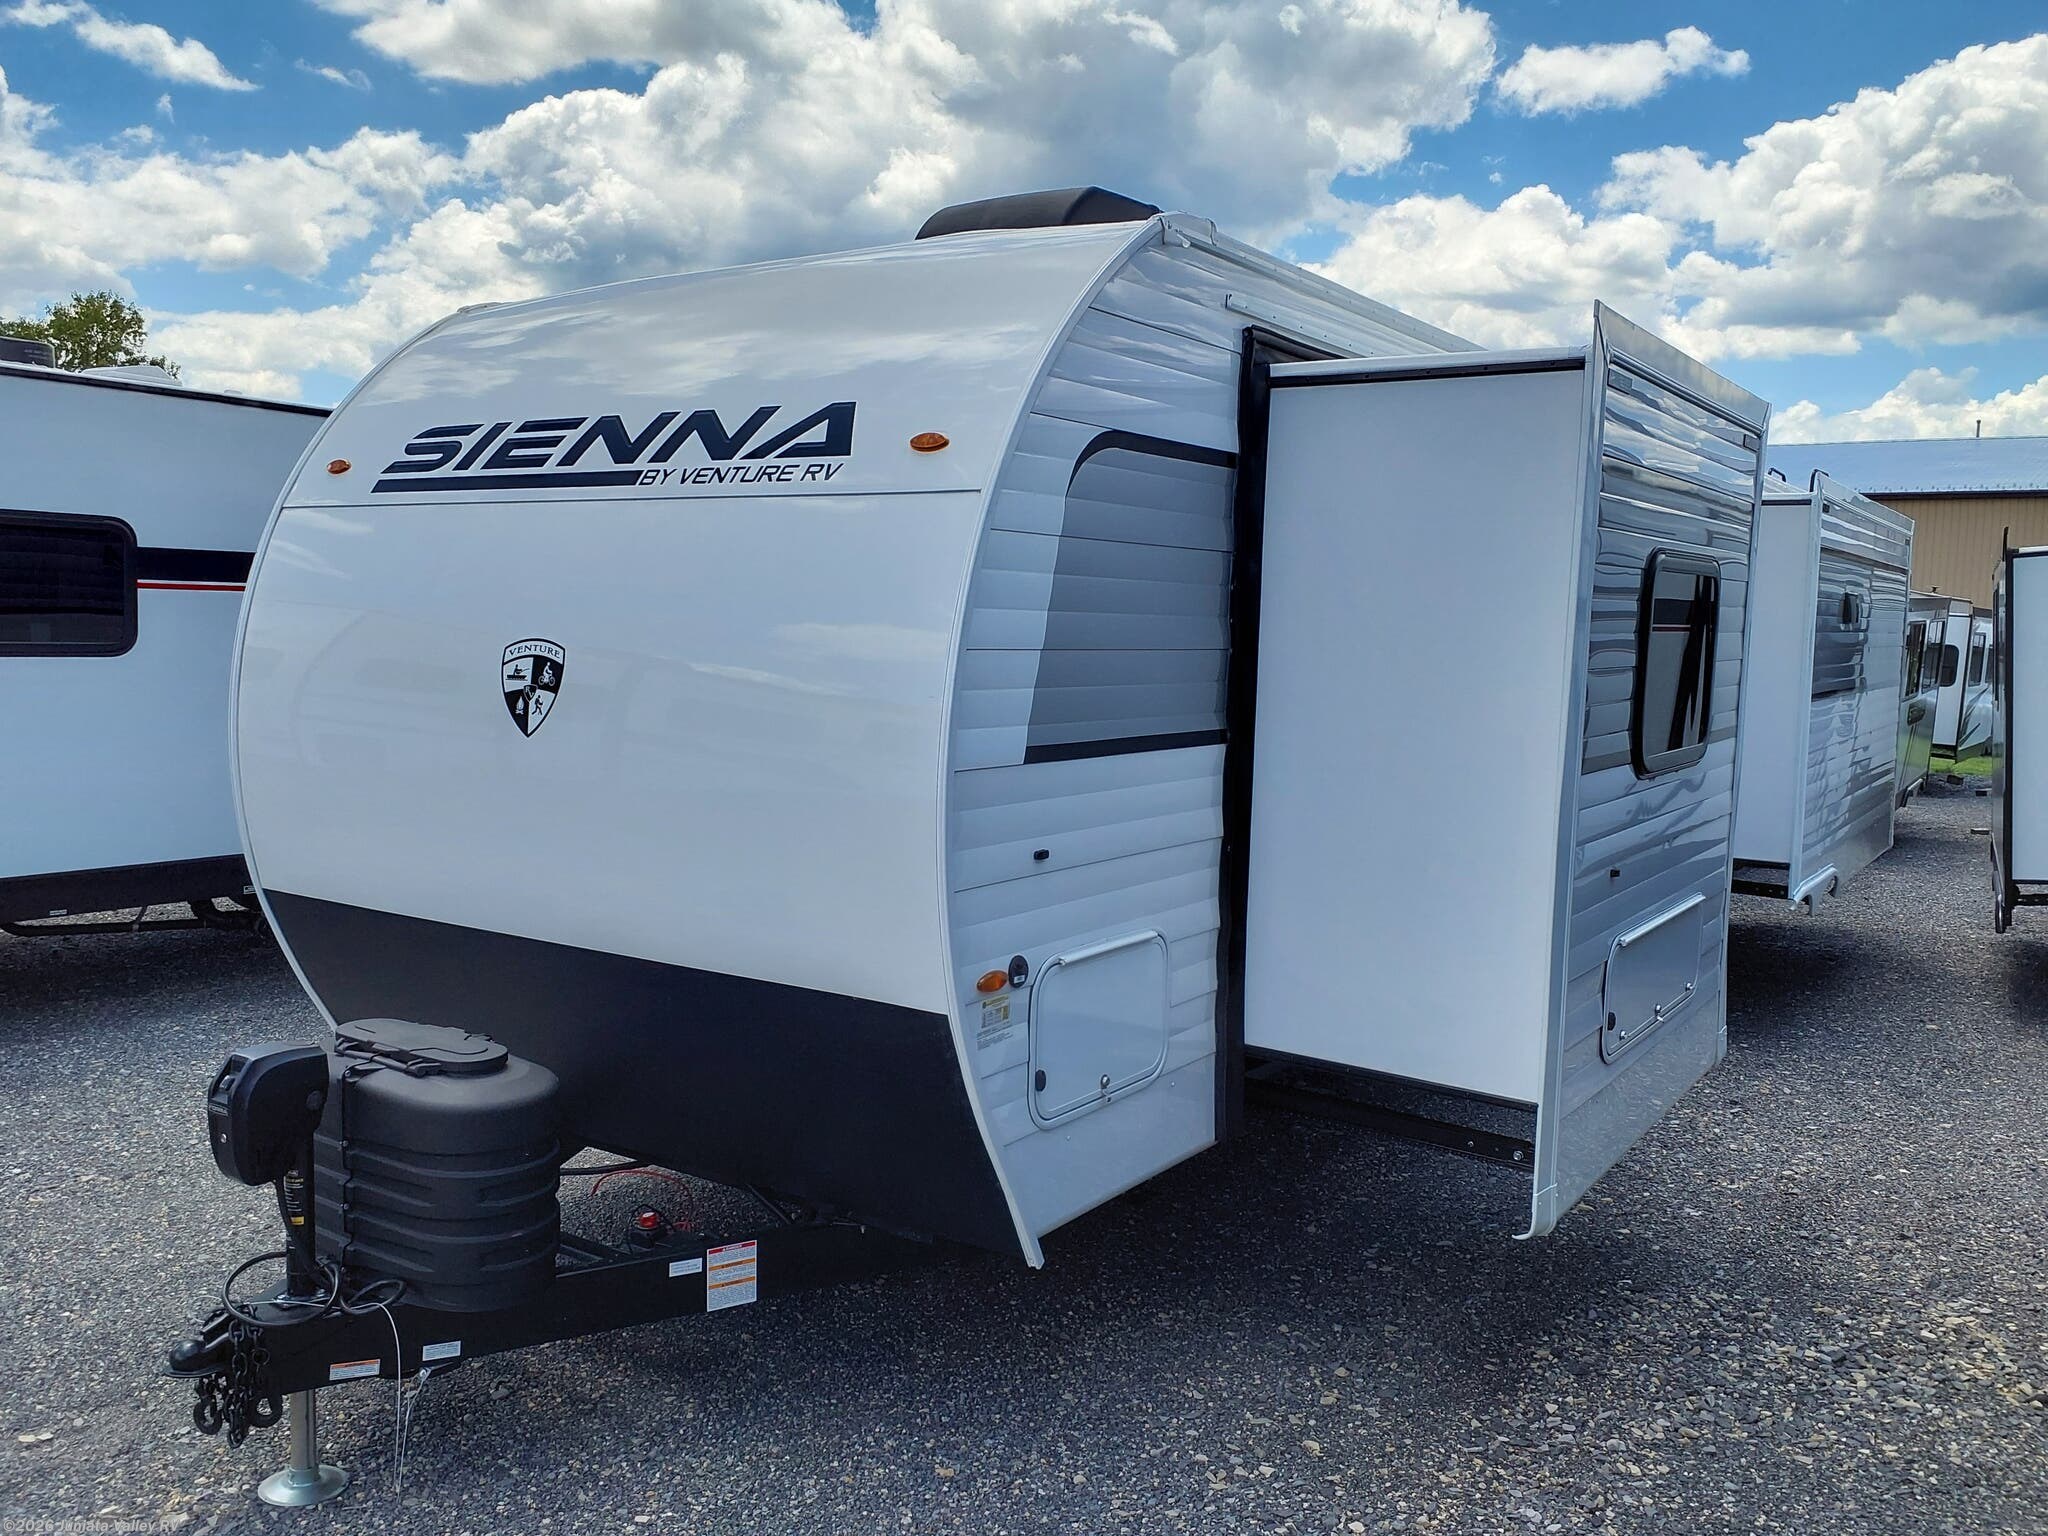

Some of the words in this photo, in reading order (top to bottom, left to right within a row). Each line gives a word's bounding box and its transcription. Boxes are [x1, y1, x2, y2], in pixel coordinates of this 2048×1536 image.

[381, 401, 857, 474] SIENNA
[638, 468, 677, 485] BY
[680, 464, 799, 485] VENTURE
[800, 462, 845, 482] RV
[509, 644, 561, 659] VENTURE
